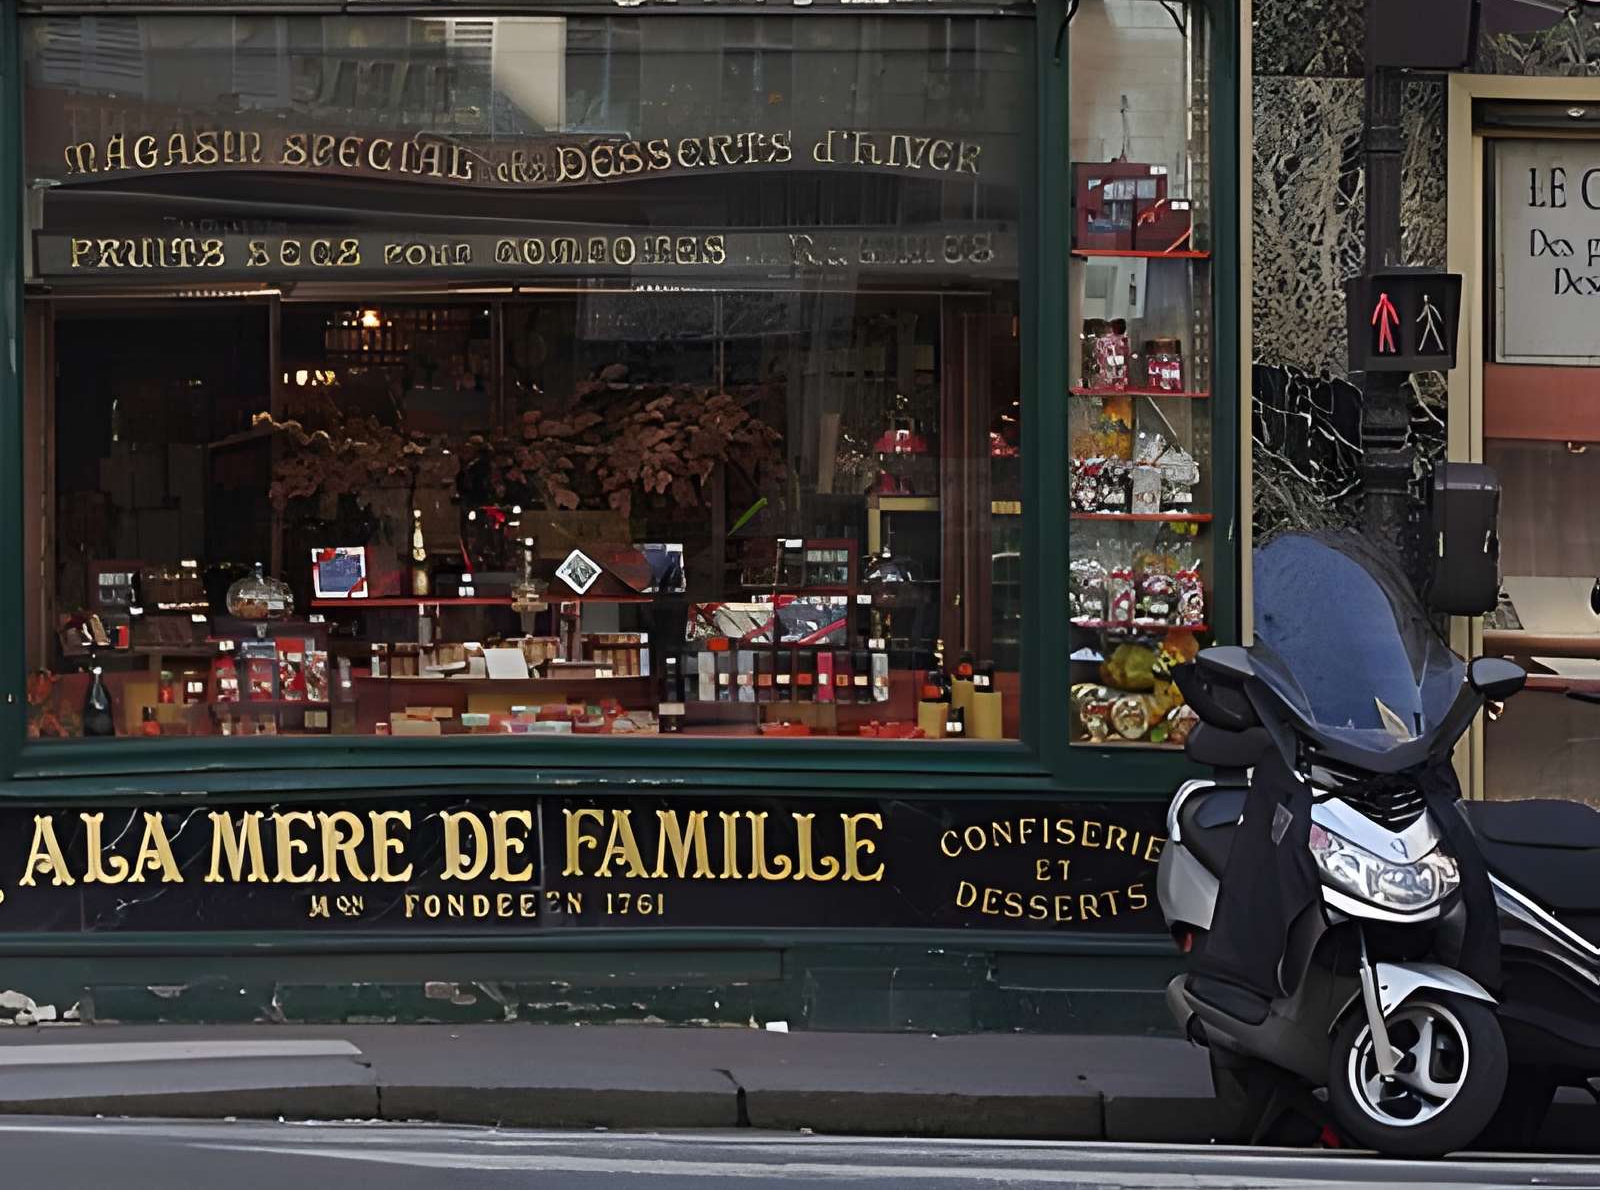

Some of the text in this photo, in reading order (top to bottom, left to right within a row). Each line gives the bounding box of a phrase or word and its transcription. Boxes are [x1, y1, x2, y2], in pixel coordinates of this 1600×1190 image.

[19, 813, 76, 887] A
[80, 811, 184, 884] LA
[439, 809, 534, 882] DE
[561, 808, 886, 883] FAMILLE
[940, 817, 1168, 863] CONFISERIE
[1036, 858, 1071, 881] ET
[606, 892, 665, 915] 1761
[955, 880, 1148, 922] DESSERTS
